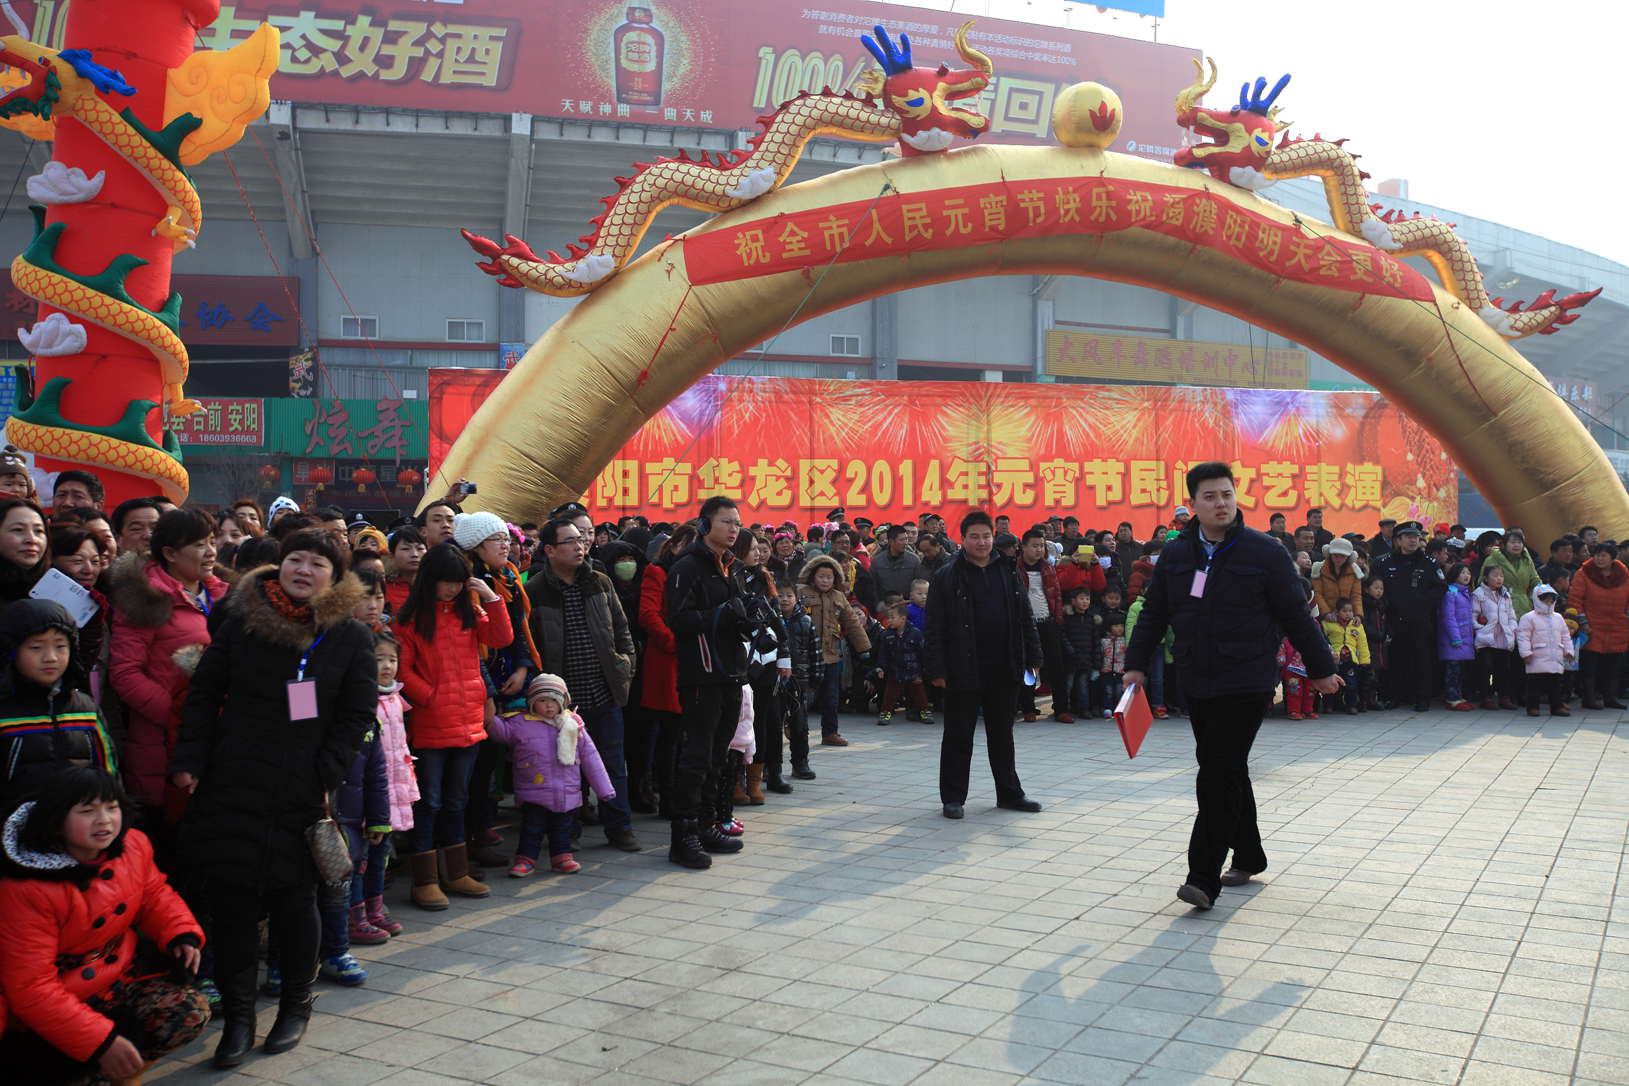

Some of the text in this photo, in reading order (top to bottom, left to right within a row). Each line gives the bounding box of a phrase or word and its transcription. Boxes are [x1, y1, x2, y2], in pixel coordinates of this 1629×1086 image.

[645, 108, 713, 123] 一曲天成
[734, 184, 1403, 288] 祝全市人民元宵节快乐祝福濮阳明天会更好
[180, 301, 286, 332] 协会
[228, 402, 258, 432] 安阳
[586, 456, 1384, 510] 阳市华龙区2014年元宵节民文艺表演
